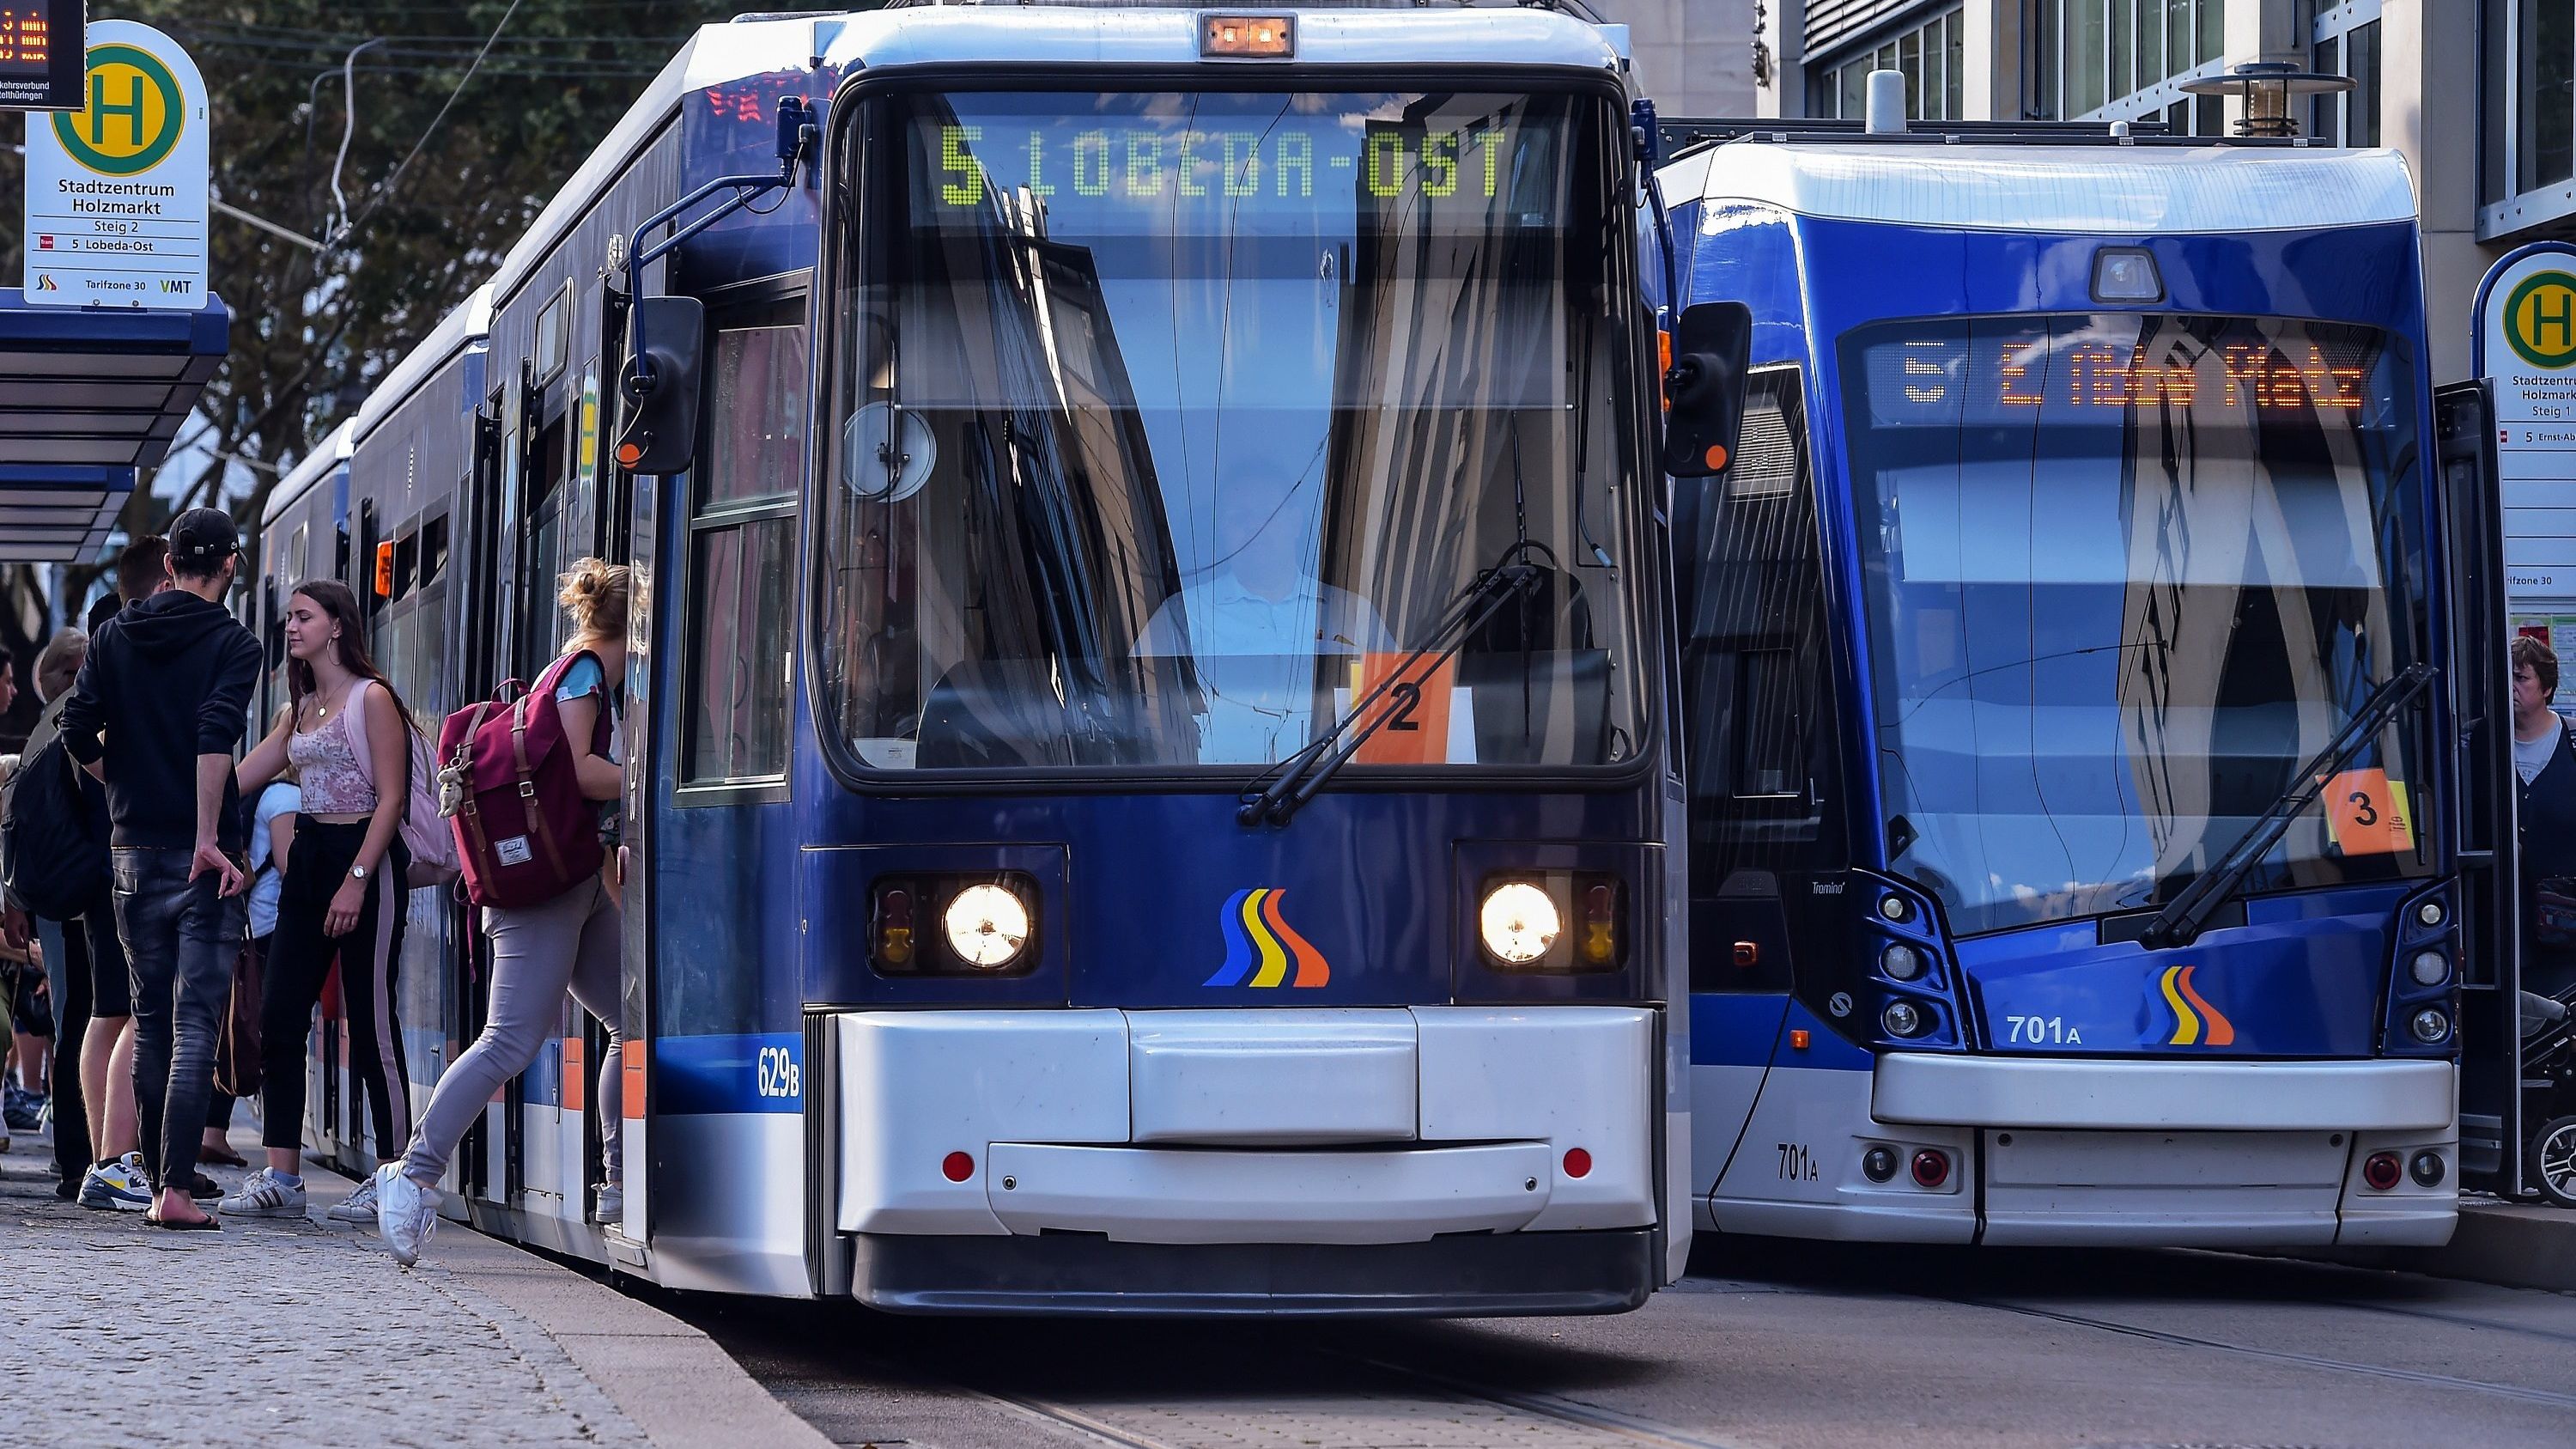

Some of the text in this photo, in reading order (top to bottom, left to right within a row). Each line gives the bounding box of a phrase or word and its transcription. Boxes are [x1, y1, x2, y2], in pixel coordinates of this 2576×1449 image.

[943, 125, 1505, 206] 5 LOBEDA-OST
[58, 179, 175, 198] Stadtzentrum
[73, 198, 161, 216] Holzmarkt
[94, 220, 139, 234] Steig 2
[72, 239, 79, 249] 5
[86, 240, 154, 252] Lobeda-Ost
[86, 279, 191, 294] Tarifzone 30 VMT
[1905, 342, 1945, 403] 5
[2225, 346, 2361, 406] Platz
[2532, 405, 2571, 418] Steig 1
[2525, 431, 2576, 443] 5 Ernst-Ab
[2541, 576, 2552, 585] 30
[1387, 682, 1421, 731] 2
[2349, 791, 2378, 826] 3
[2006, 1016, 2083, 1045] 701A
[757, 1046, 800, 1098] 629B
[1777, 1143, 1820, 1183] 701A
